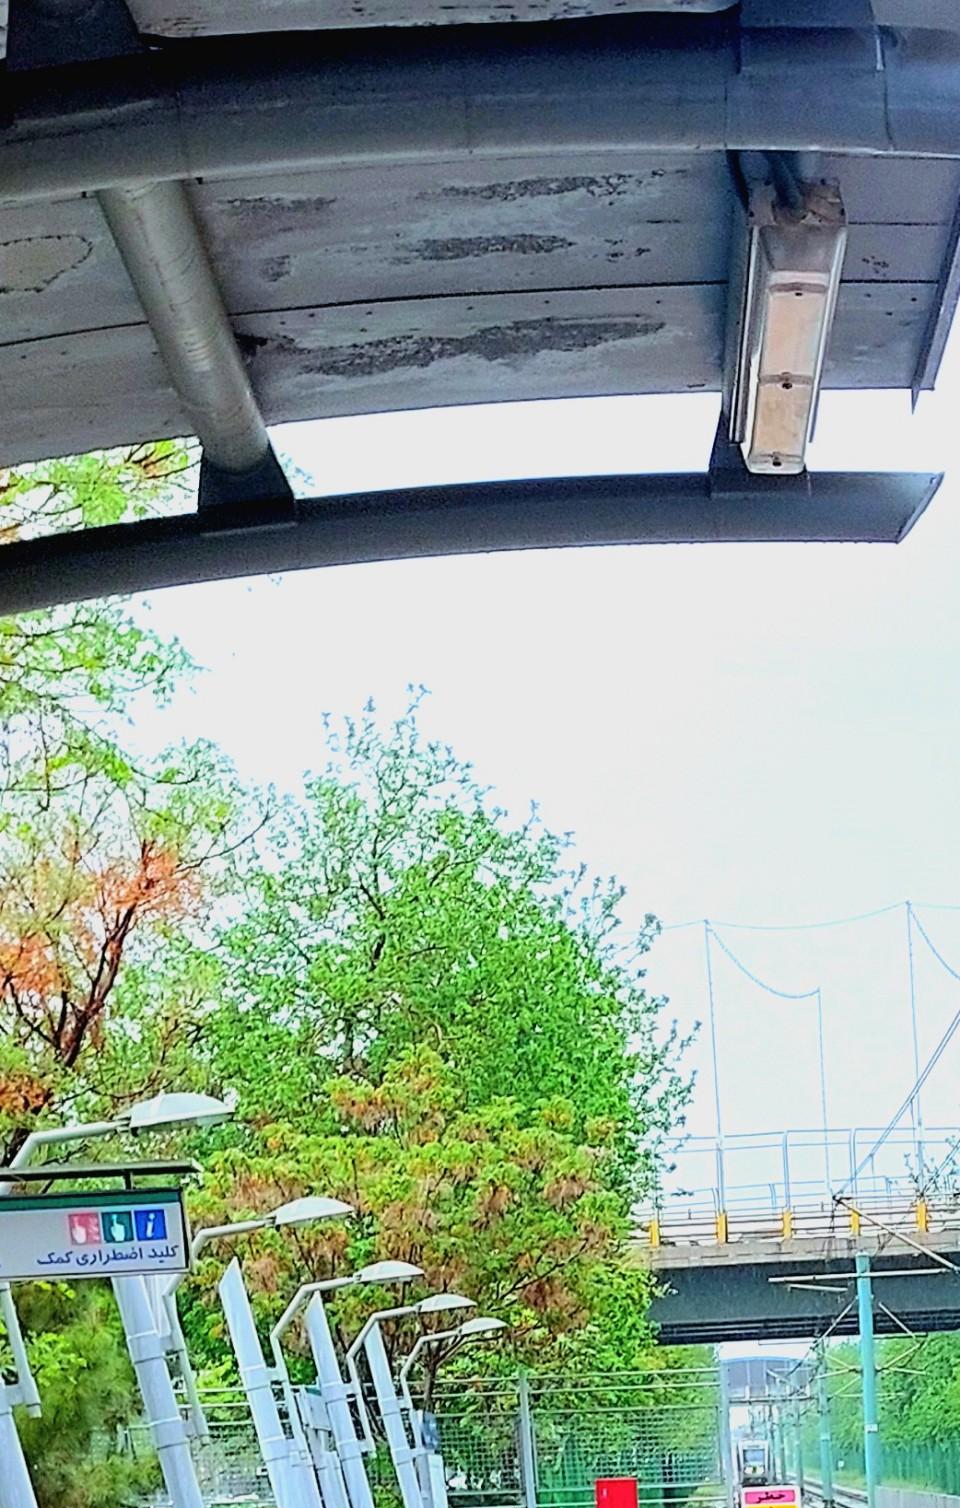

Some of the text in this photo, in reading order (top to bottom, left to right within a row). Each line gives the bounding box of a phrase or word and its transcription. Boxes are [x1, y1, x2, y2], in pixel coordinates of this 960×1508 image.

[37, 1244, 180, 1267] کلید اضطراری کمک
